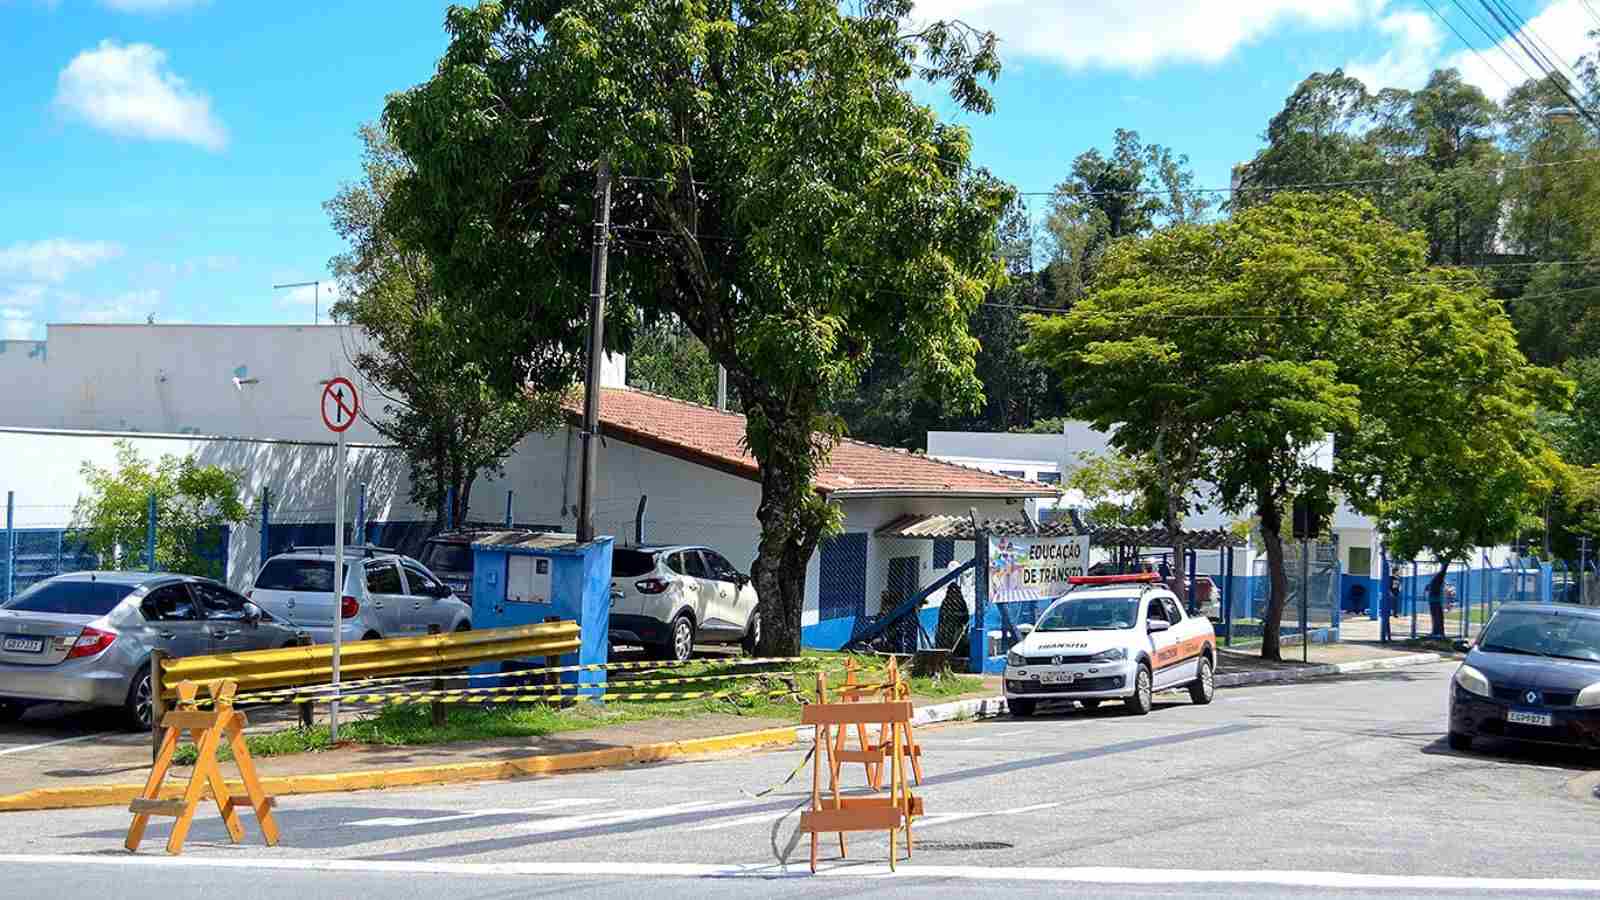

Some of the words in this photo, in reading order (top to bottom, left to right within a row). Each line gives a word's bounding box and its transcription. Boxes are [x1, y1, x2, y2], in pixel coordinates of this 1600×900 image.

[1029, 541, 1081, 563] EDUCAÇÃO
[1023, 568, 1037, 584] DE
[1040, 564, 1083, 583] TRÂNSITO
